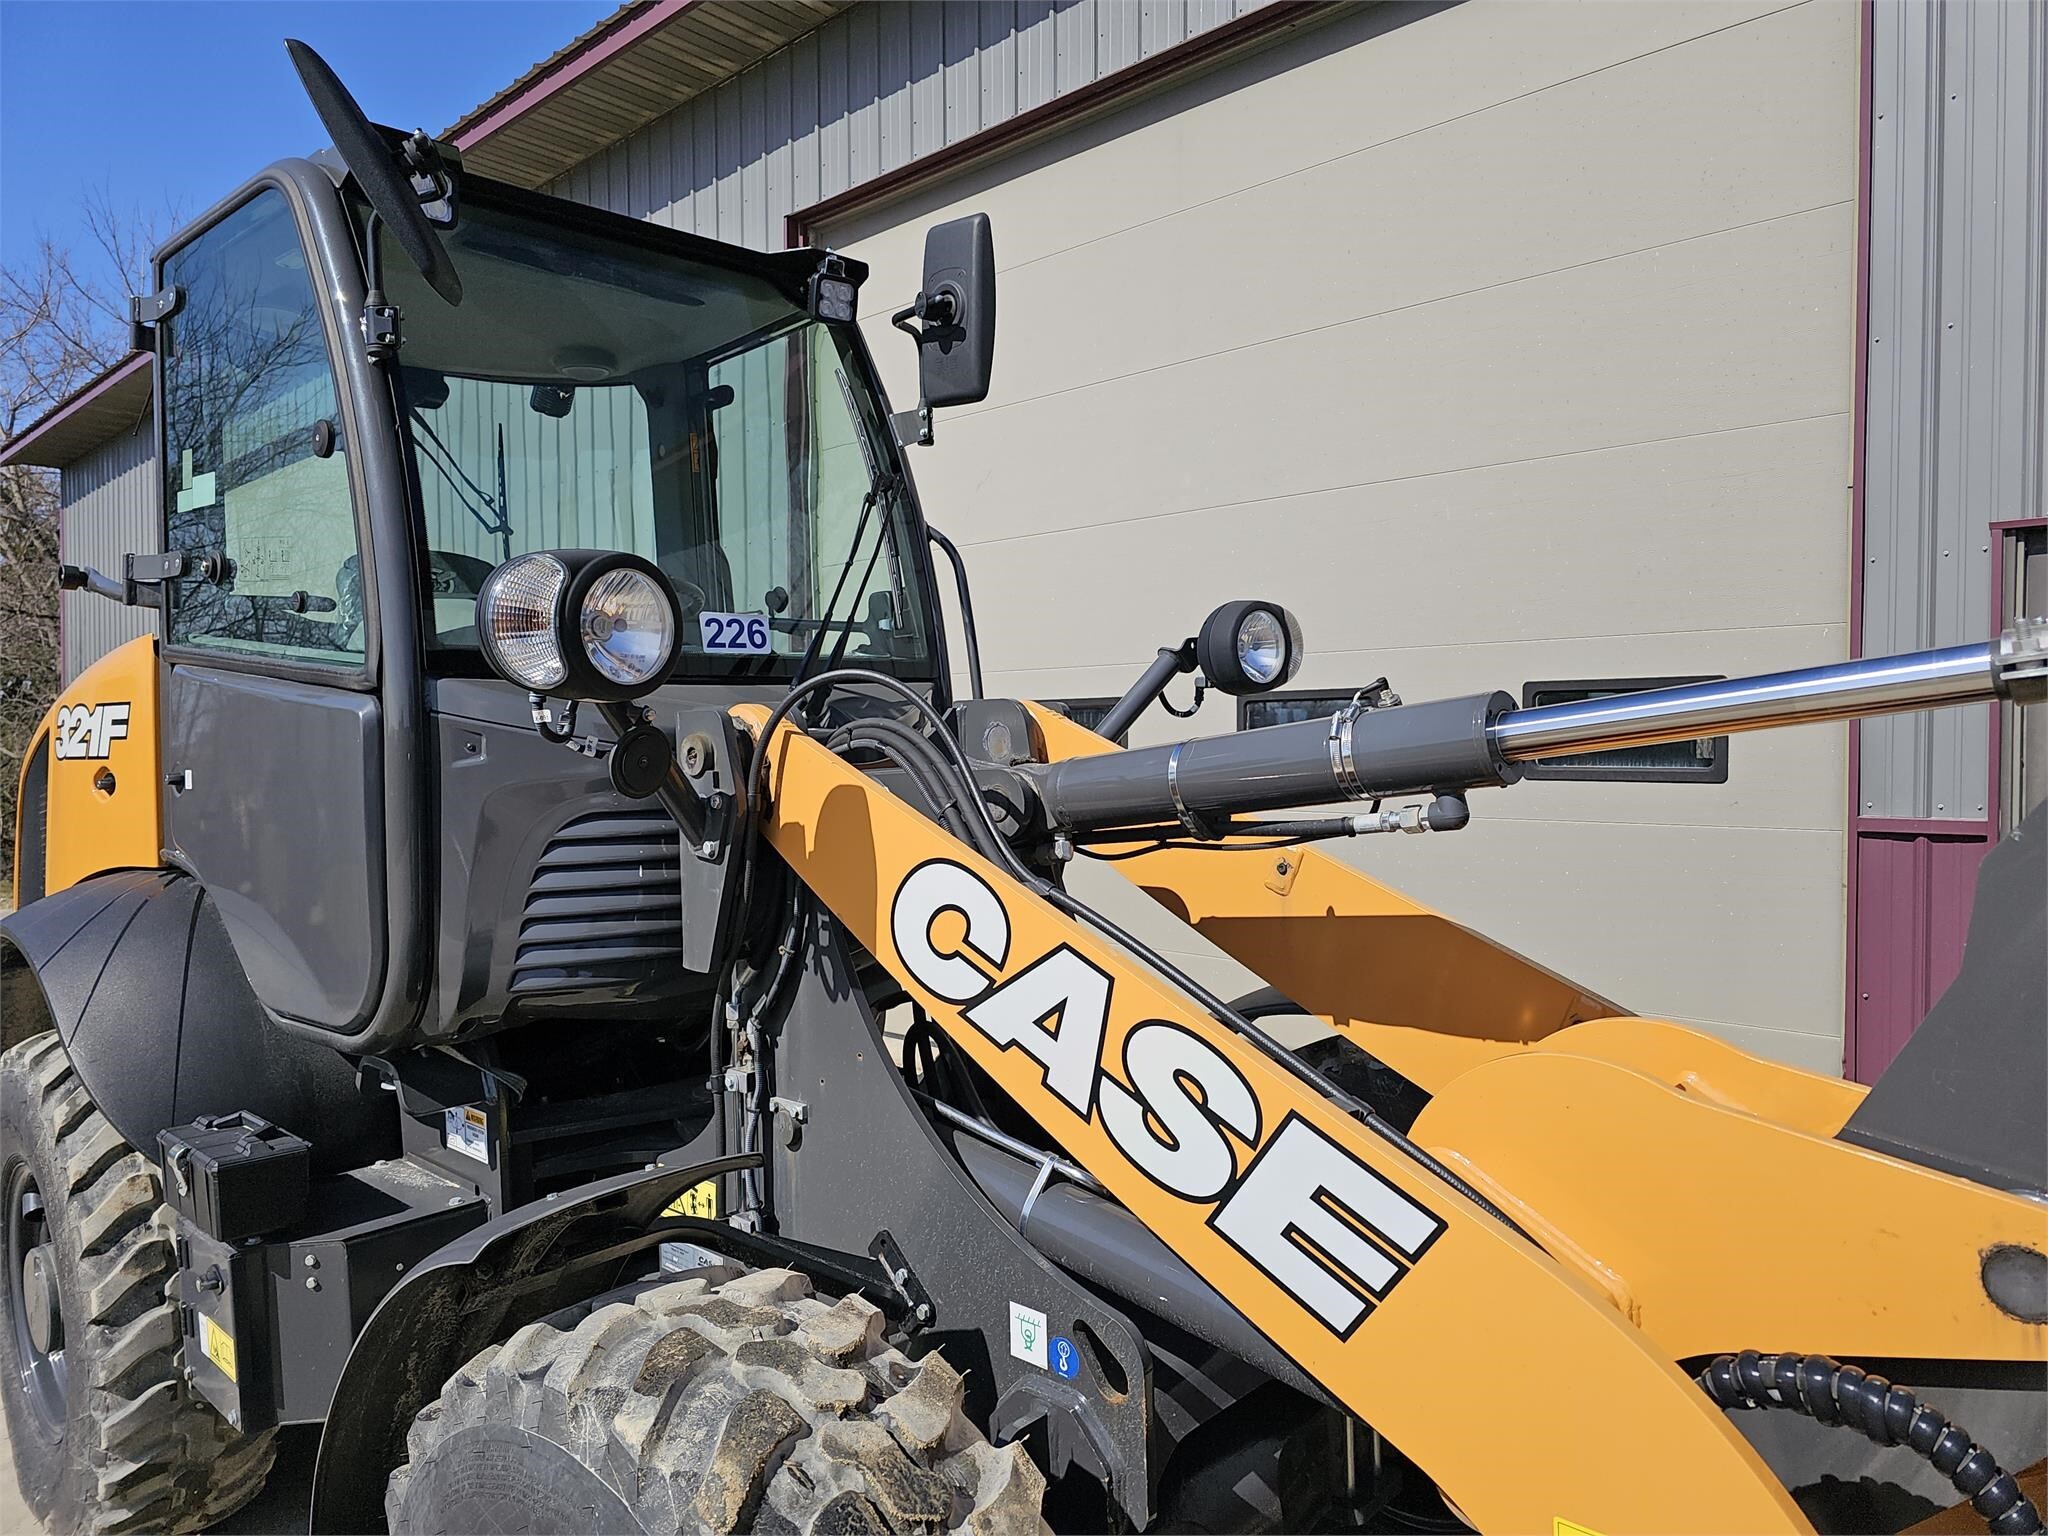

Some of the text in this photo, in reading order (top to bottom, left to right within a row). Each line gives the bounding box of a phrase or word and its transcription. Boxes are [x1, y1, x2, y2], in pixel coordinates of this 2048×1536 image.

[705, 618, 767, 649] 226
[55, 702, 131, 761] 321F
[891, 858, 1448, 1343] CASE
